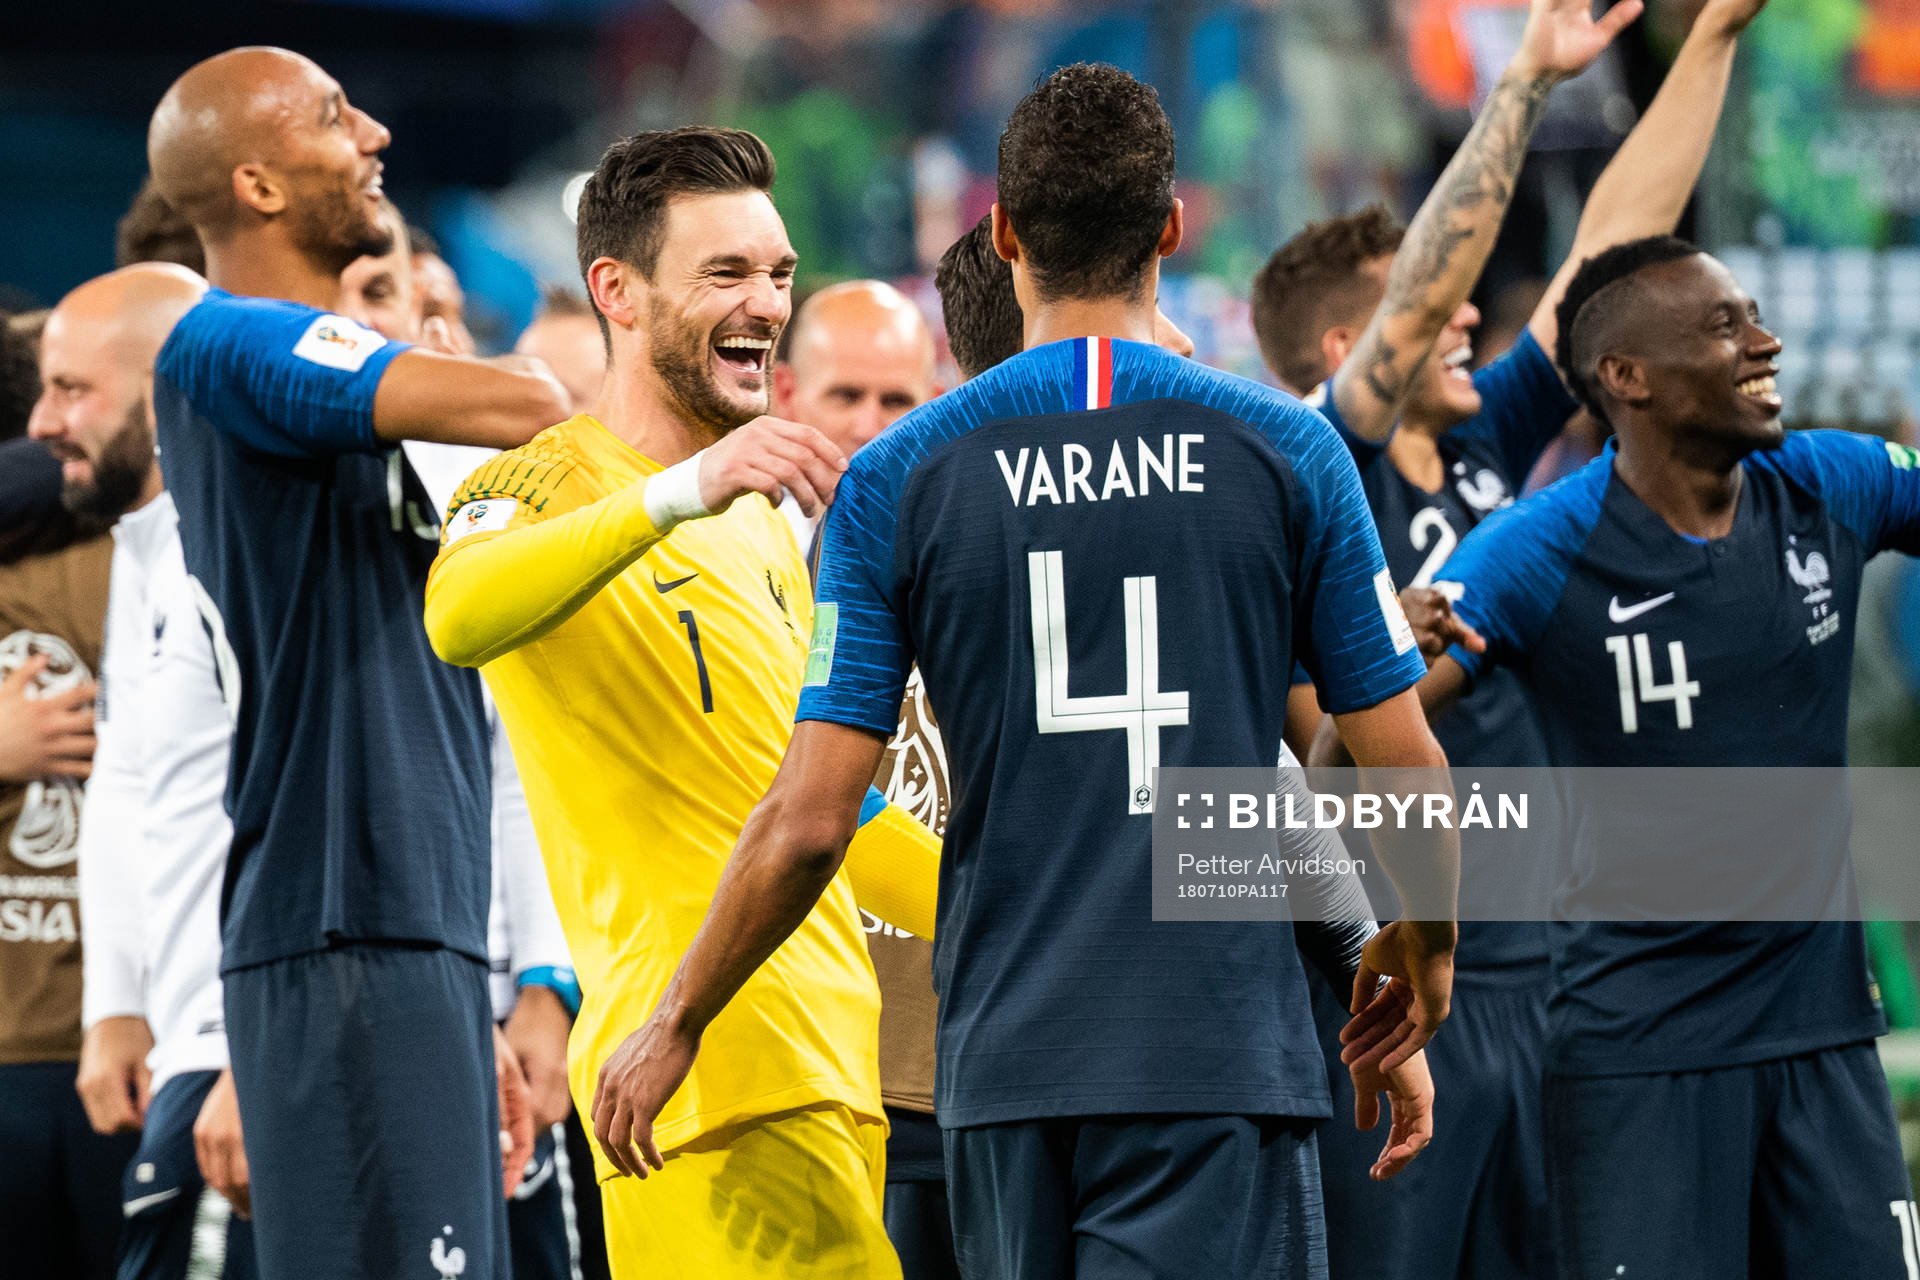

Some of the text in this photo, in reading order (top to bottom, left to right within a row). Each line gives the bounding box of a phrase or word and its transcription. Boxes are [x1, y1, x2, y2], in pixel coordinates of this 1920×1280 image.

[994, 433, 1205, 508] VARANE
[1409, 507, 1465, 605] 2
[677, 610, 714, 714] 1
[1028, 551, 1190, 815] 4
[1605, 633, 1701, 734] 14
